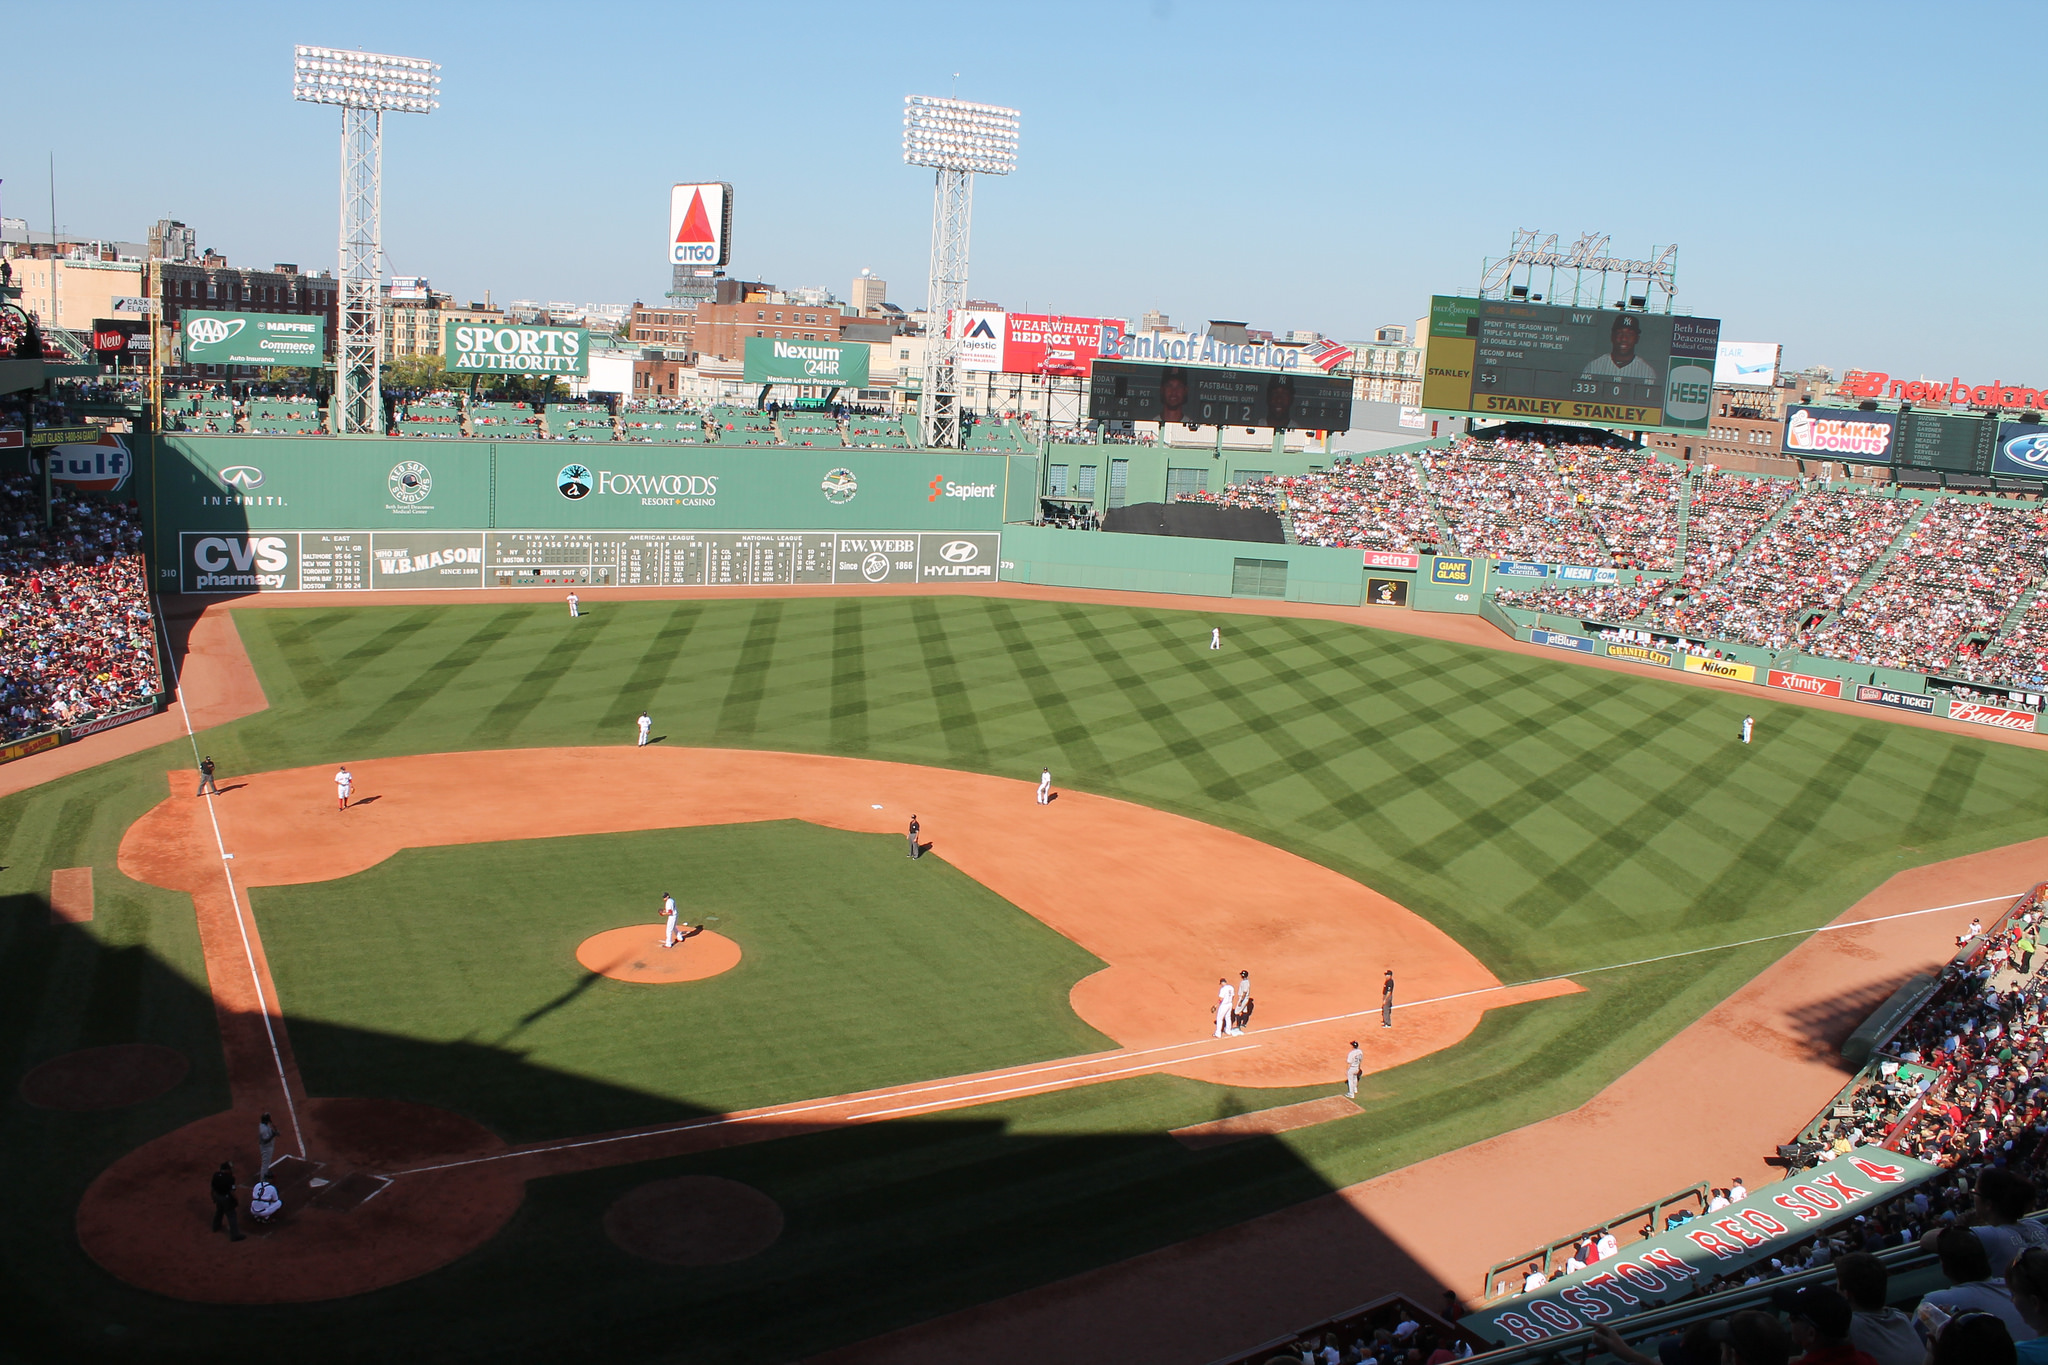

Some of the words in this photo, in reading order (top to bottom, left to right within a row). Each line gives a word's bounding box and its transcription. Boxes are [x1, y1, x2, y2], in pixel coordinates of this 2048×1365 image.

[675, 245, 714, 261] CITGO
[127, 298, 149, 306] CASK
[1572, 313, 1592, 324] NYY
[192, 320, 223, 342] AAA
[267, 322, 315, 332] MAPFRE
[1011, 320, 1048, 332] WEAR
[1052, 323, 1089, 334] WHAT
[1483, 329, 1511, 337] TRIPLE-A
[1674, 323, 1693, 332] Beth
[1695, 325, 1718, 335] Israel
[100, 334, 121, 349] New
[456, 326, 579, 356] SPORTS
[1012, 332, 1041, 343] RED
[1490, 338, 1516, 346] DOUBLES
[1673, 334, 1717, 344] Deaconess
[260, 340, 315, 351] Commerce
[774, 341, 839, 360] Nexium
[1100, 326, 1167, 357] Bank
[1168, 333, 1198, 361] of
[1199, 335, 1299, 368] America
[1672, 342, 1696, 350] Medical
[1480, 349, 1504, 357] SECOND
[456, 352, 578, 371] AUTHORITY
[1428, 368, 1470, 378] STANLEY
[1481, 374, 1497, 383] 5-3
[1200, 382, 1232, 390] FASTBALL
[1573, 383, 1596, 393] .333
[1613, 386, 1620, 396] 0
[1889, 379, 1950, 401] new
[1669, 382, 1708, 404] HESS
[1203, 404, 1211, 418] 0
[1242, 406, 1250, 420] 2
[1487, 397, 1561, 415] STANLEY
[1573, 403, 1647, 422] STANLEY
[1816, 422, 1890, 439] DUNKIN'
[32, 433, 47, 443] GIANT
[48, 433, 64, 442] GLASS
[83, 431, 97, 440] GIANT
[1815, 436, 1882, 453] DONUTS
[407, 463, 424, 474] SOX
[598, 471, 717, 496] FOXWOODS
[392, 479, 430, 501] SCHOLARS
[946, 482, 995, 501] Sapient
[642, 498, 673, 506] RESORT
[868, 540, 914, 552] WEBB
[194, 537, 288, 571] CVS
[393, 550, 408, 558] BUT
[1371, 554, 1409, 566] aetna
[839, 562, 858, 570] Since
[895, 562, 913, 570] 1866
[924, 566, 991, 576] HYUNDAI
[1000, 561, 1014, 569] 379
[1439, 562, 1466, 571] GIANT
[1513, 562, 1534, 570] Boston
[161, 569, 176, 577] 310
[1437, 570, 1467, 580] GLASS
[1508, 567, 1541, 576] Scientific
[1563, 568, 1592, 579] NESN
[196, 573, 286, 589] pharmacy
[1546, 632, 1579, 648] jetBlue
[1608, 646, 1649, 658] GRANITE
[1650, 651, 1670, 664] CITY
[1701, 661, 1737, 677] Nikon
[1882, 693, 1900, 703] ACE
[1901, 695, 1933, 709] TICKET
[1493, 1248, 1699, 1343] BOSTON
[1685, 1208, 1788, 1261] RED
[1773, 1171, 1872, 1222] SOX
